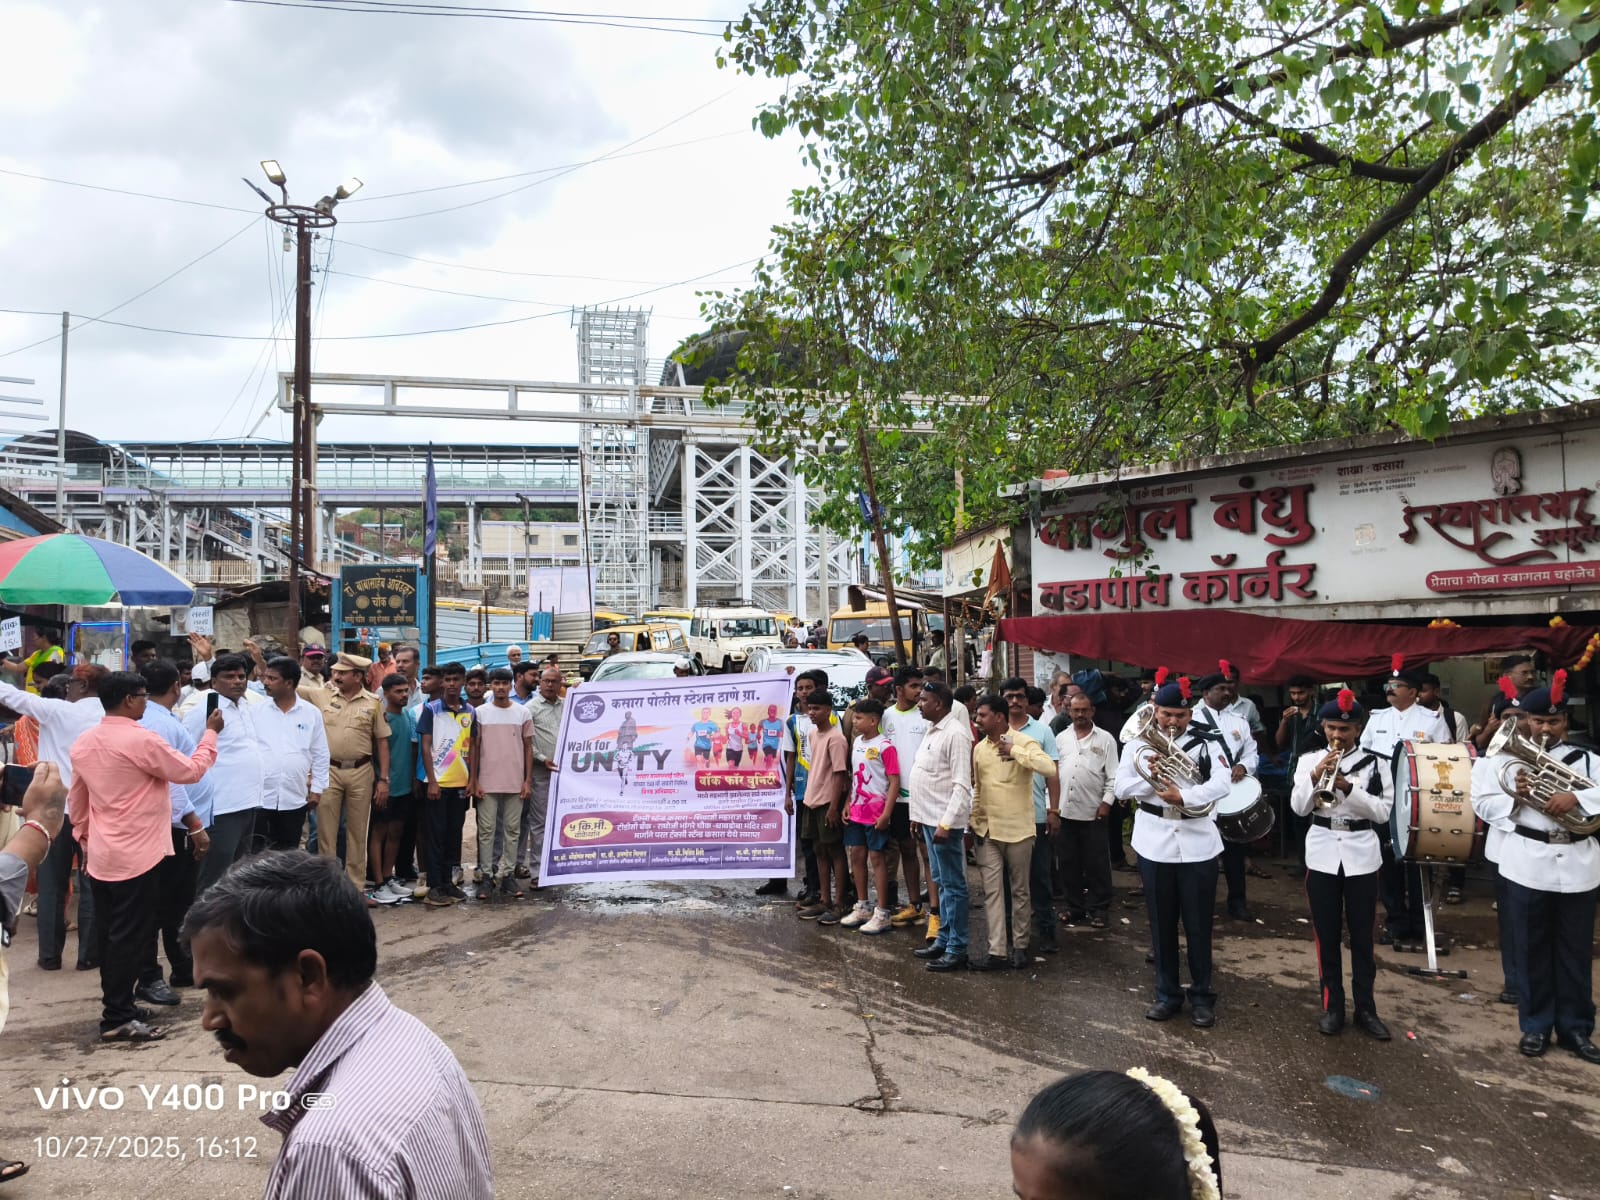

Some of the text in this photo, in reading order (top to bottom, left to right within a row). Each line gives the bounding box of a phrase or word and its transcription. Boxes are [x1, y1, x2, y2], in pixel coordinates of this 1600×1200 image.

[1372, 460, 1404, 472] कसारा
[1210, 475, 1315, 548] बंधु
[1038, 549, 1318, 610] वडापाव कॉर्नर
[1431, 575, 1463, 587] प्रेमाचा
[1502, 570, 1550, 583] स्वागतम
[611, 697, 645, 709] कसारा
[648, 692, 681, 707] पोलीस
[684, 690, 715, 704] स्टेशन
[718, 687, 740, 702] ठाणे
[567, 739, 611, 752] Walk for
[571, 748, 672, 773] UNTY
[724, 773, 744, 787] फॉर
